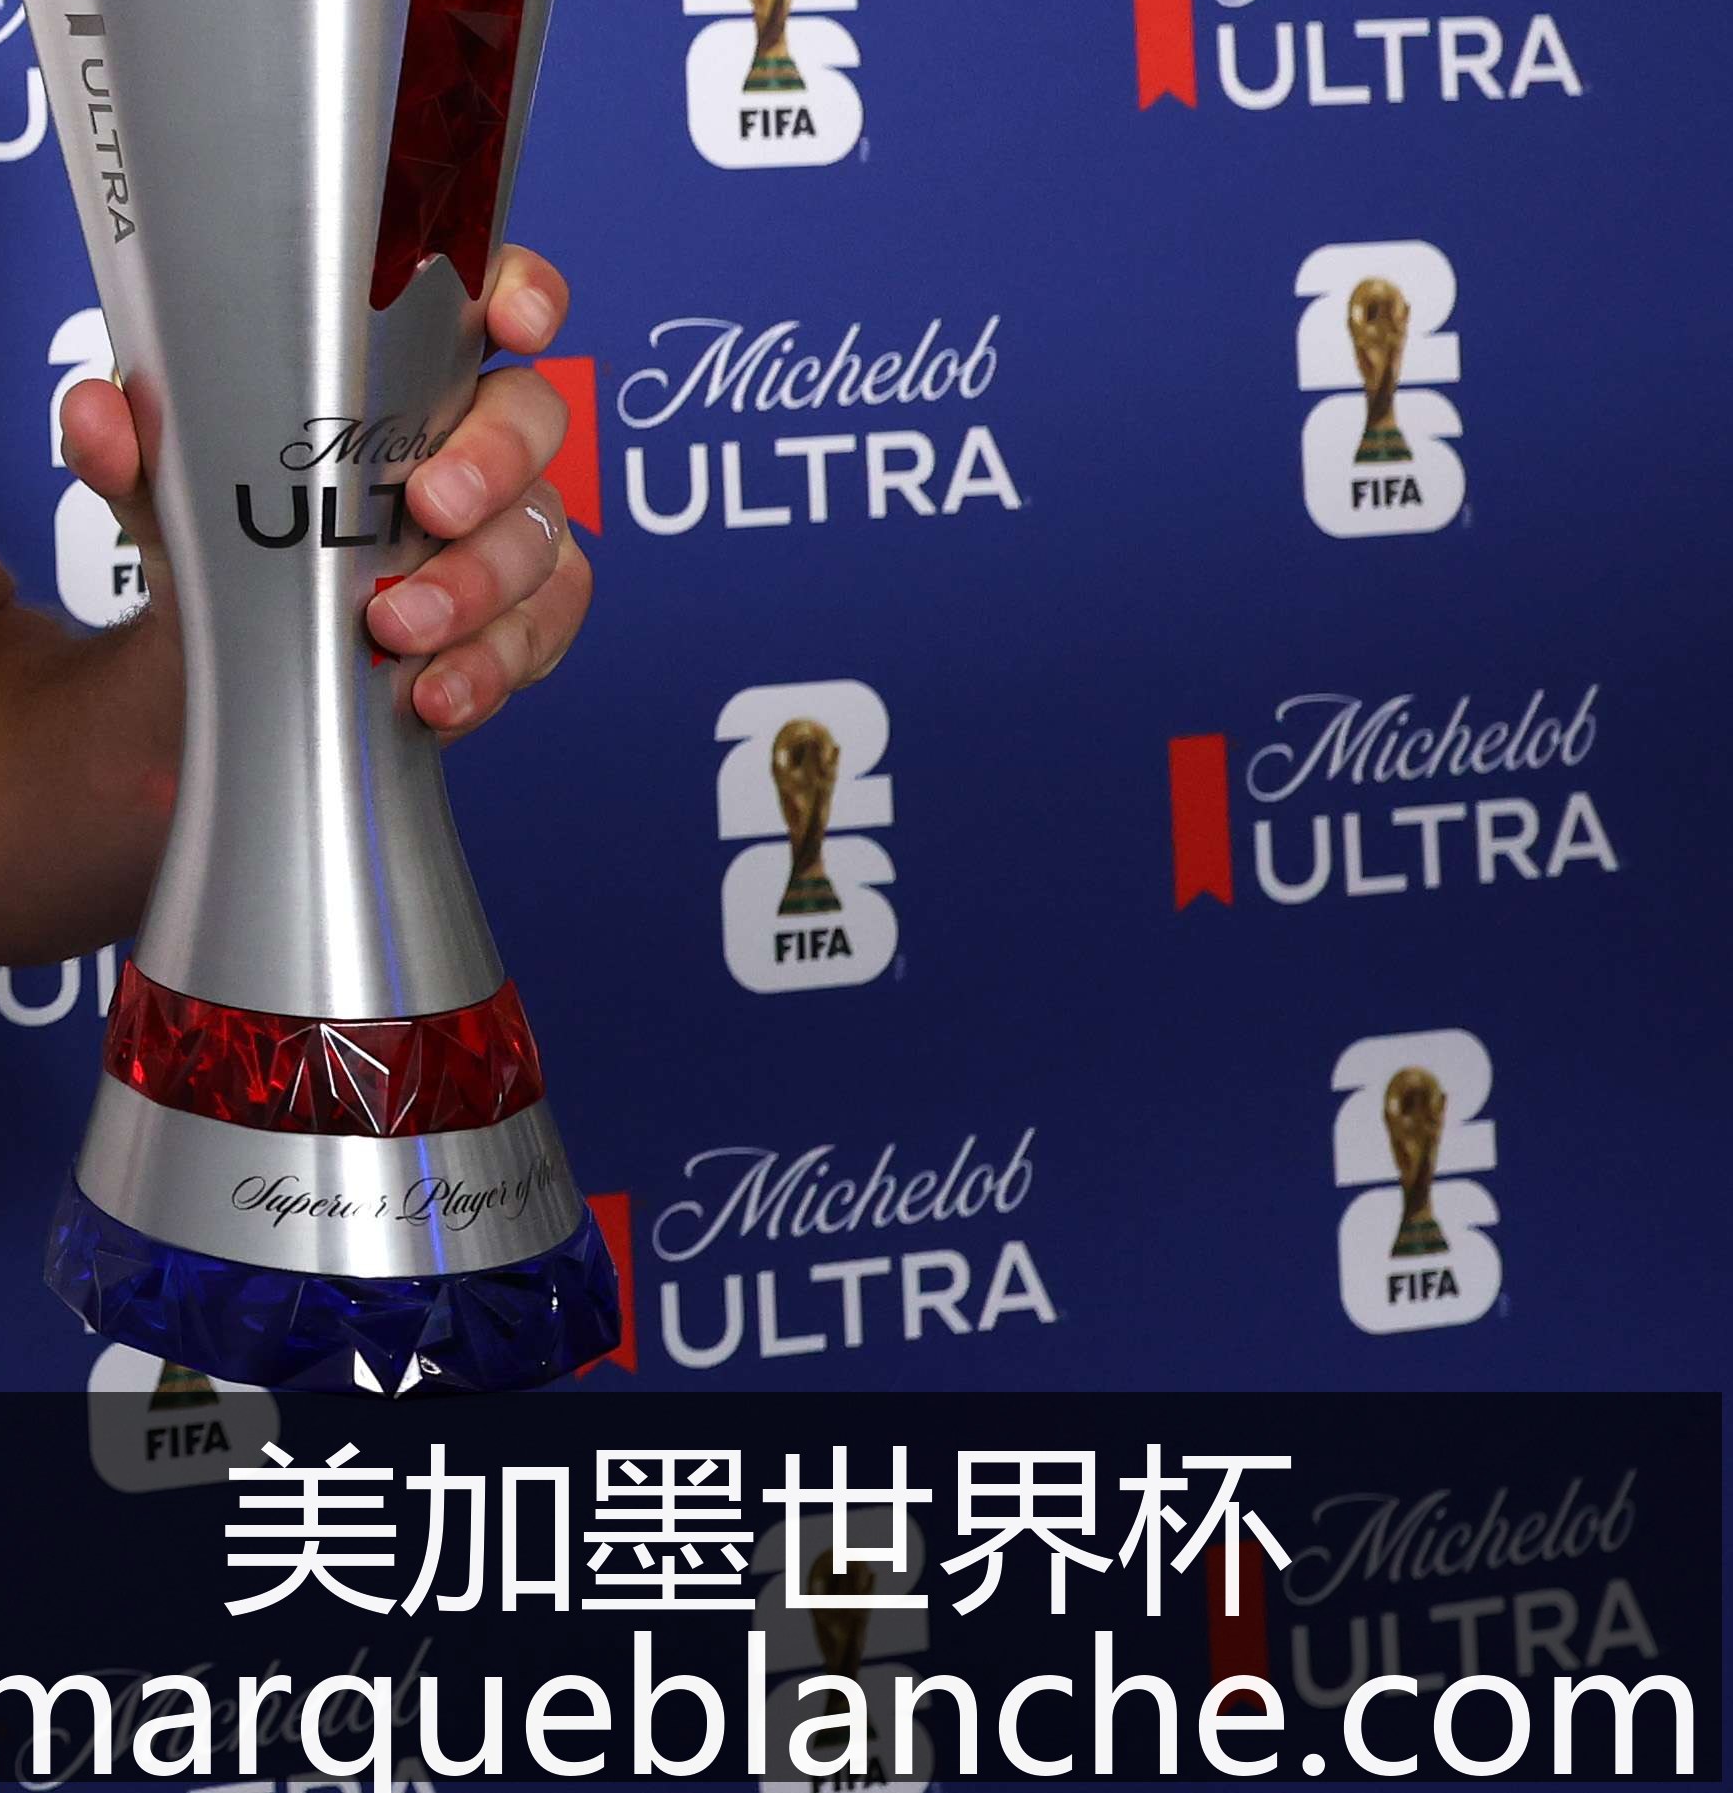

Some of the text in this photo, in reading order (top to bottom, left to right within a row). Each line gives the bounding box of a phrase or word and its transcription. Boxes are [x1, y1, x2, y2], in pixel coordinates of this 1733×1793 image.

[1216, 13, 1584, 111] ULTRA
[81, 57, 137, 244] ULTRA
[739, 107, 816, 139] FIFA
[616, 314, 1001, 430] Michelob
[279, 415, 450, 472] Miche
[624, 424, 1023, 536] ULTRA
[234, 481, 408, 550] ULT
[1350, 477, 1423, 509] FIFA
[1246, 683, 1599, 803] Michelob
[1253, 791, 1619, 905] ULTRA
[774, 926, 853, 964] FIFA
[394, 1176, 508, 1232] Player
[651, 1127, 1036, 1263] Michelob
[660, 1240, 1059, 1370] ULTRA
[1387, 1268, 1459, 1304] FIFA
[146, 1422, 230, 1461] FIFA
[1282, 1467, 1639, 1607] Michelob
